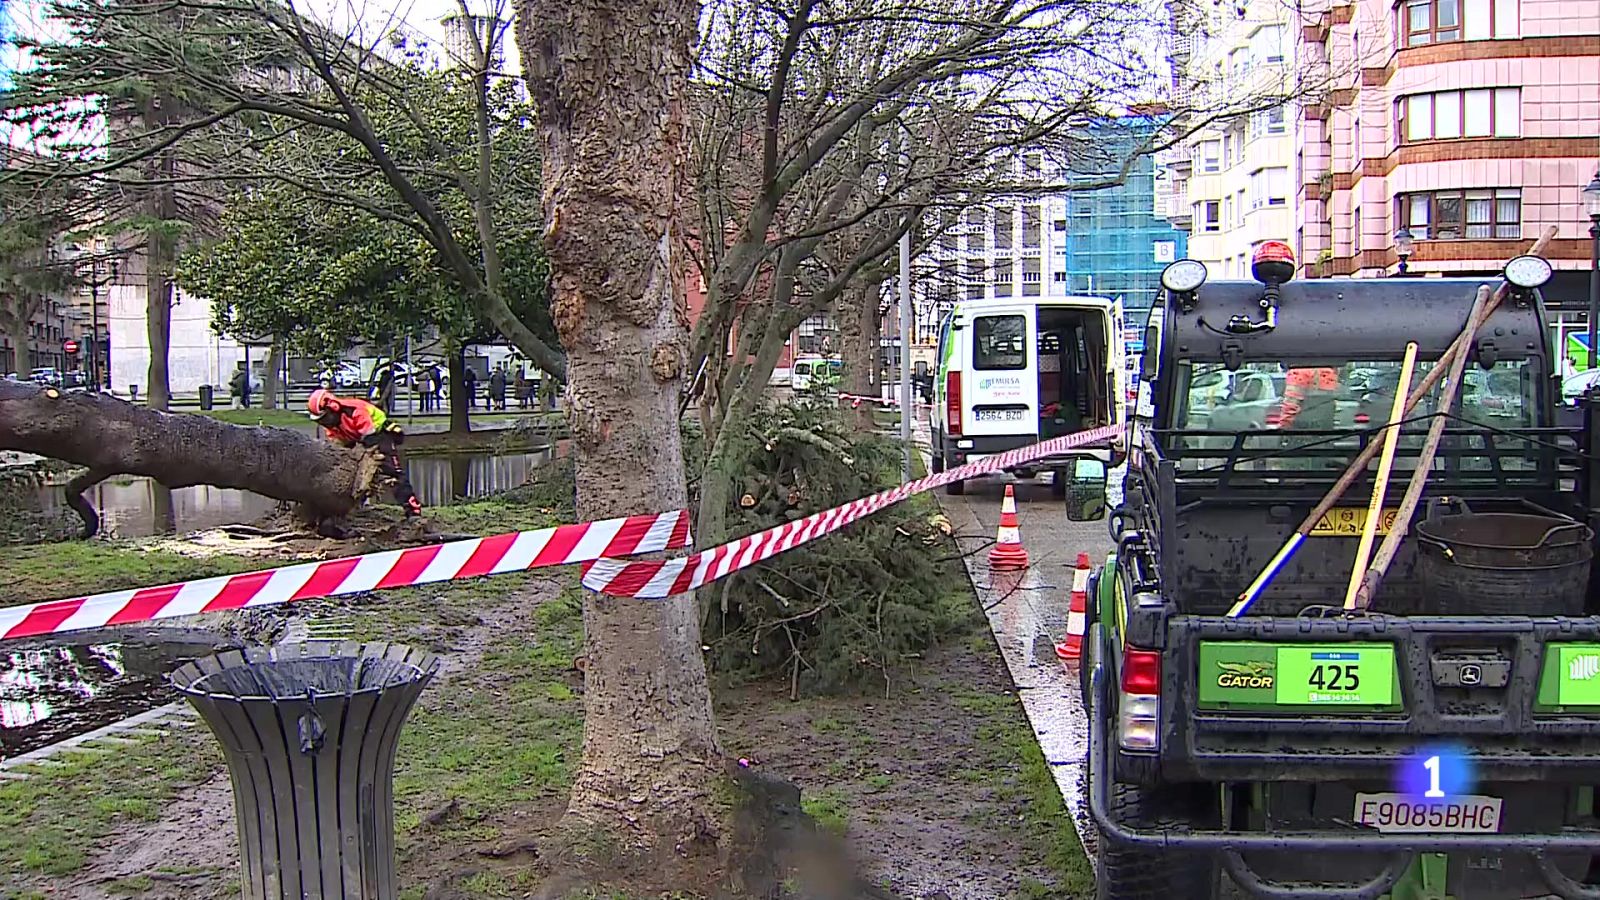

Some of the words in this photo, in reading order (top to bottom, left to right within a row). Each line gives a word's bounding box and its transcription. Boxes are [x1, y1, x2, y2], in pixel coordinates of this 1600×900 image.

[981, 410, 1002, 420] 2564
[1217, 673, 1273, 689] GATOR
[1308, 665, 1360, 691] 425
[1361, 801, 1495, 830] E9085BHC
